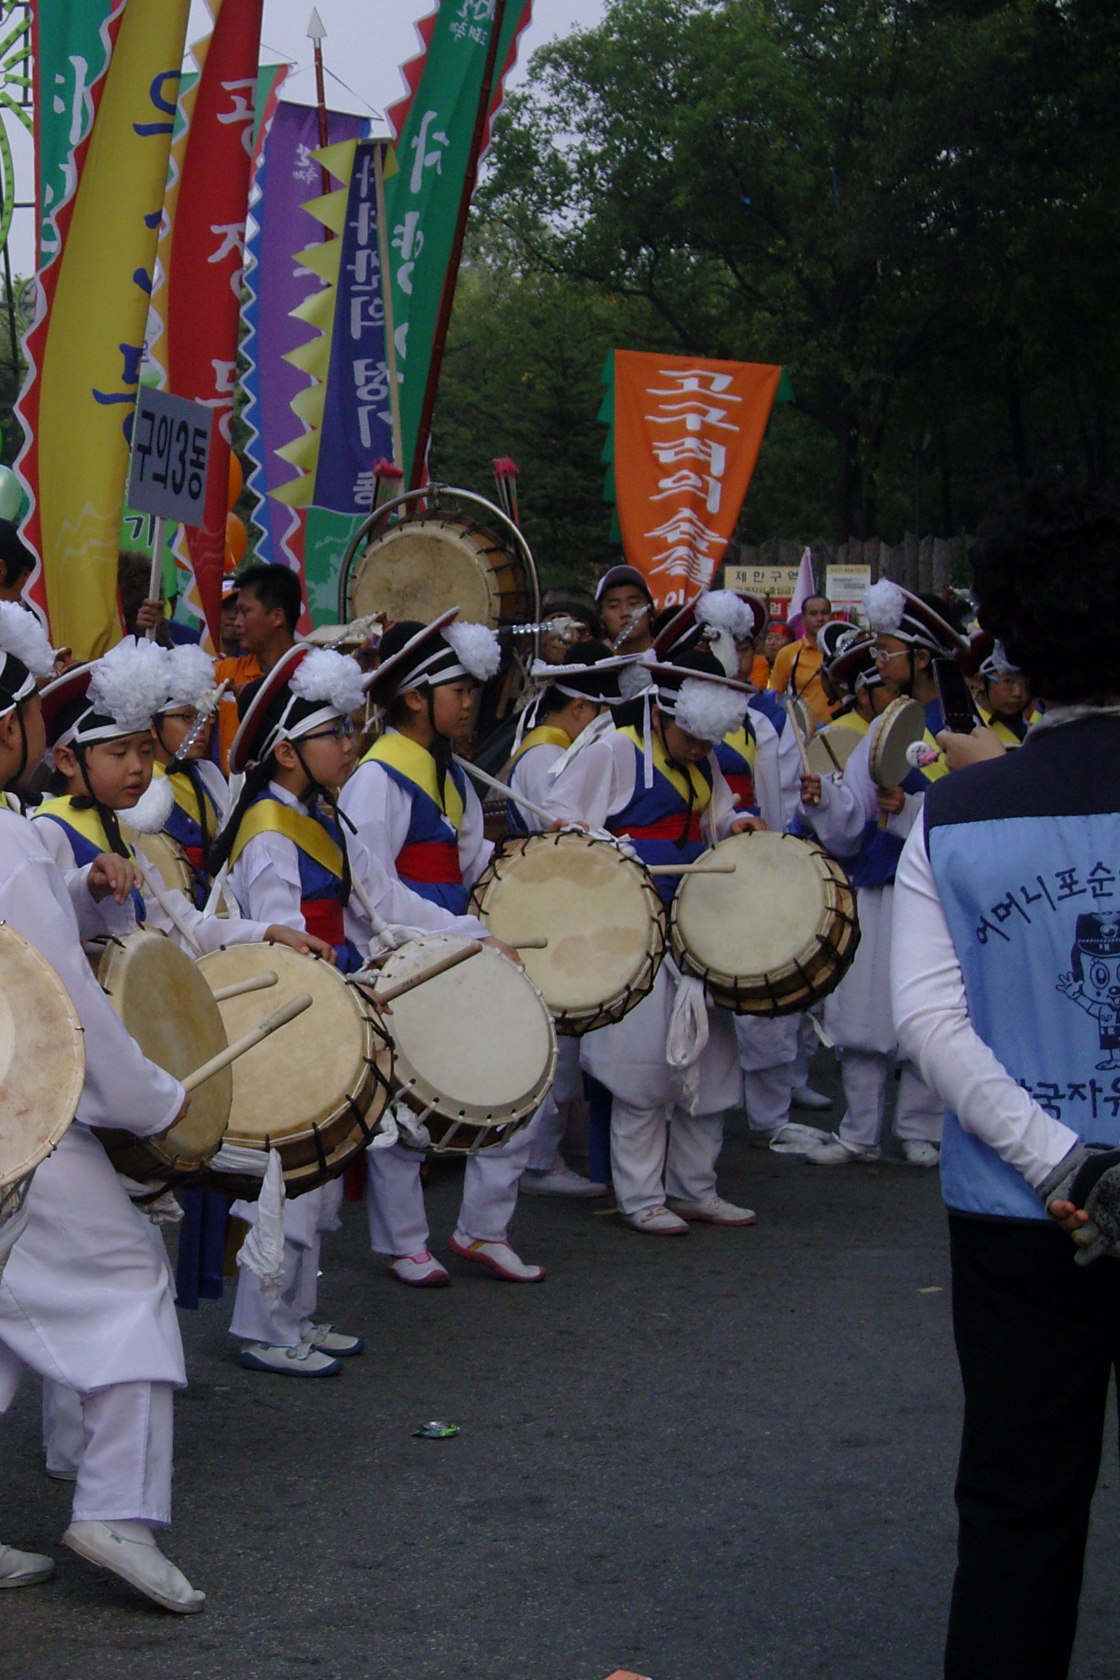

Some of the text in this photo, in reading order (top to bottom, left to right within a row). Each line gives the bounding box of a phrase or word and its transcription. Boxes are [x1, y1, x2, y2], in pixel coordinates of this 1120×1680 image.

[136, 408, 208, 500] 구의3동
[644, 369, 743, 515] 고구려의
[976, 861, 1120, 944] 어머니포순
